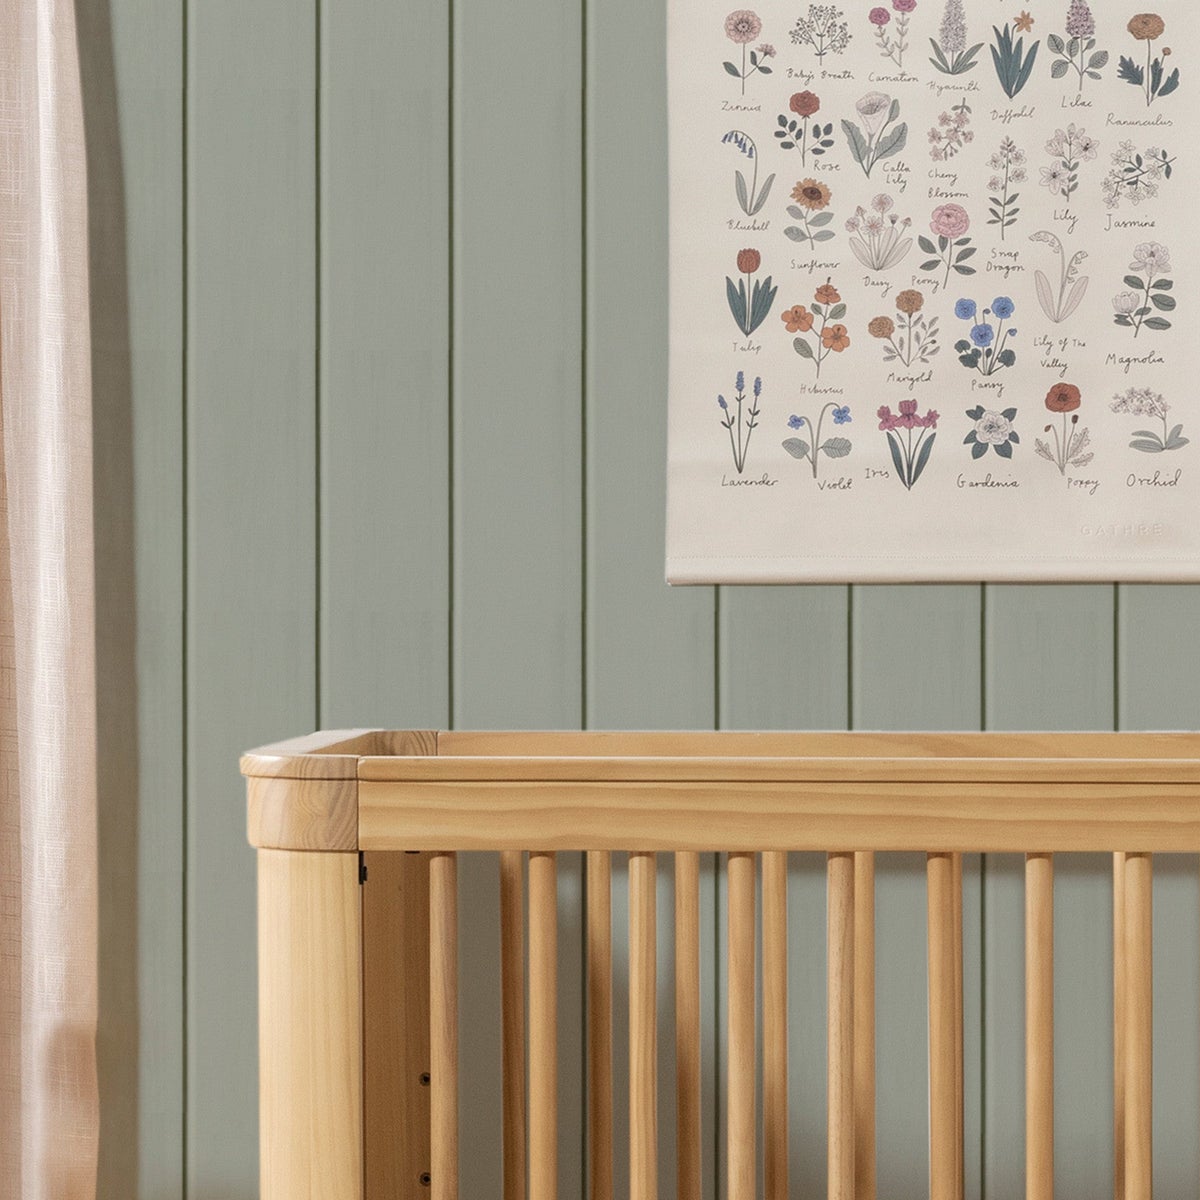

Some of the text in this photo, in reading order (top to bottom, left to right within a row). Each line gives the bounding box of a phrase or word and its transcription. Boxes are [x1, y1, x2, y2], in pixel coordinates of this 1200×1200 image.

[868, 72, 919, 83] Carnation
[1061, 95, 1093, 108] Lilac
[1105, 112, 1173, 127] Ranunculus
[813, 159, 841, 171] Rose
[882, 161, 912, 174] Calla
[886, 176, 908, 193] Lily
[928, 169, 958, 187] Cherry
[928, 187, 969, 199] Blossom
[726, 219, 770, 231] Bluebell
[1053, 209, 1079, 234] Lily
[1104, 213, 1156, 231] Jasmine
[991, 248, 1020, 262] Snap
[790, 259, 840, 274] Sunflower
[986, 263, 1025, 279] Dragon
[863, 276, 893, 297] Daisy
[911, 275, 940, 294] Peony
[1033, 334, 1054, 355] Lily
[1040, 359, 1069, 377] Valley
[1105, 351, 1165, 374] Magnolia
[971, 379, 1005, 398] Pansy
[721, 473, 779, 487] Lavender
[865, 467, 890, 479] Iris
[956, 472, 1020, 488] Gardenia
[1126, 468, 1183, 488] Orchid
[818, 478, 852, 491] Violet
[1067, 478, 1101, 495] Poppy
